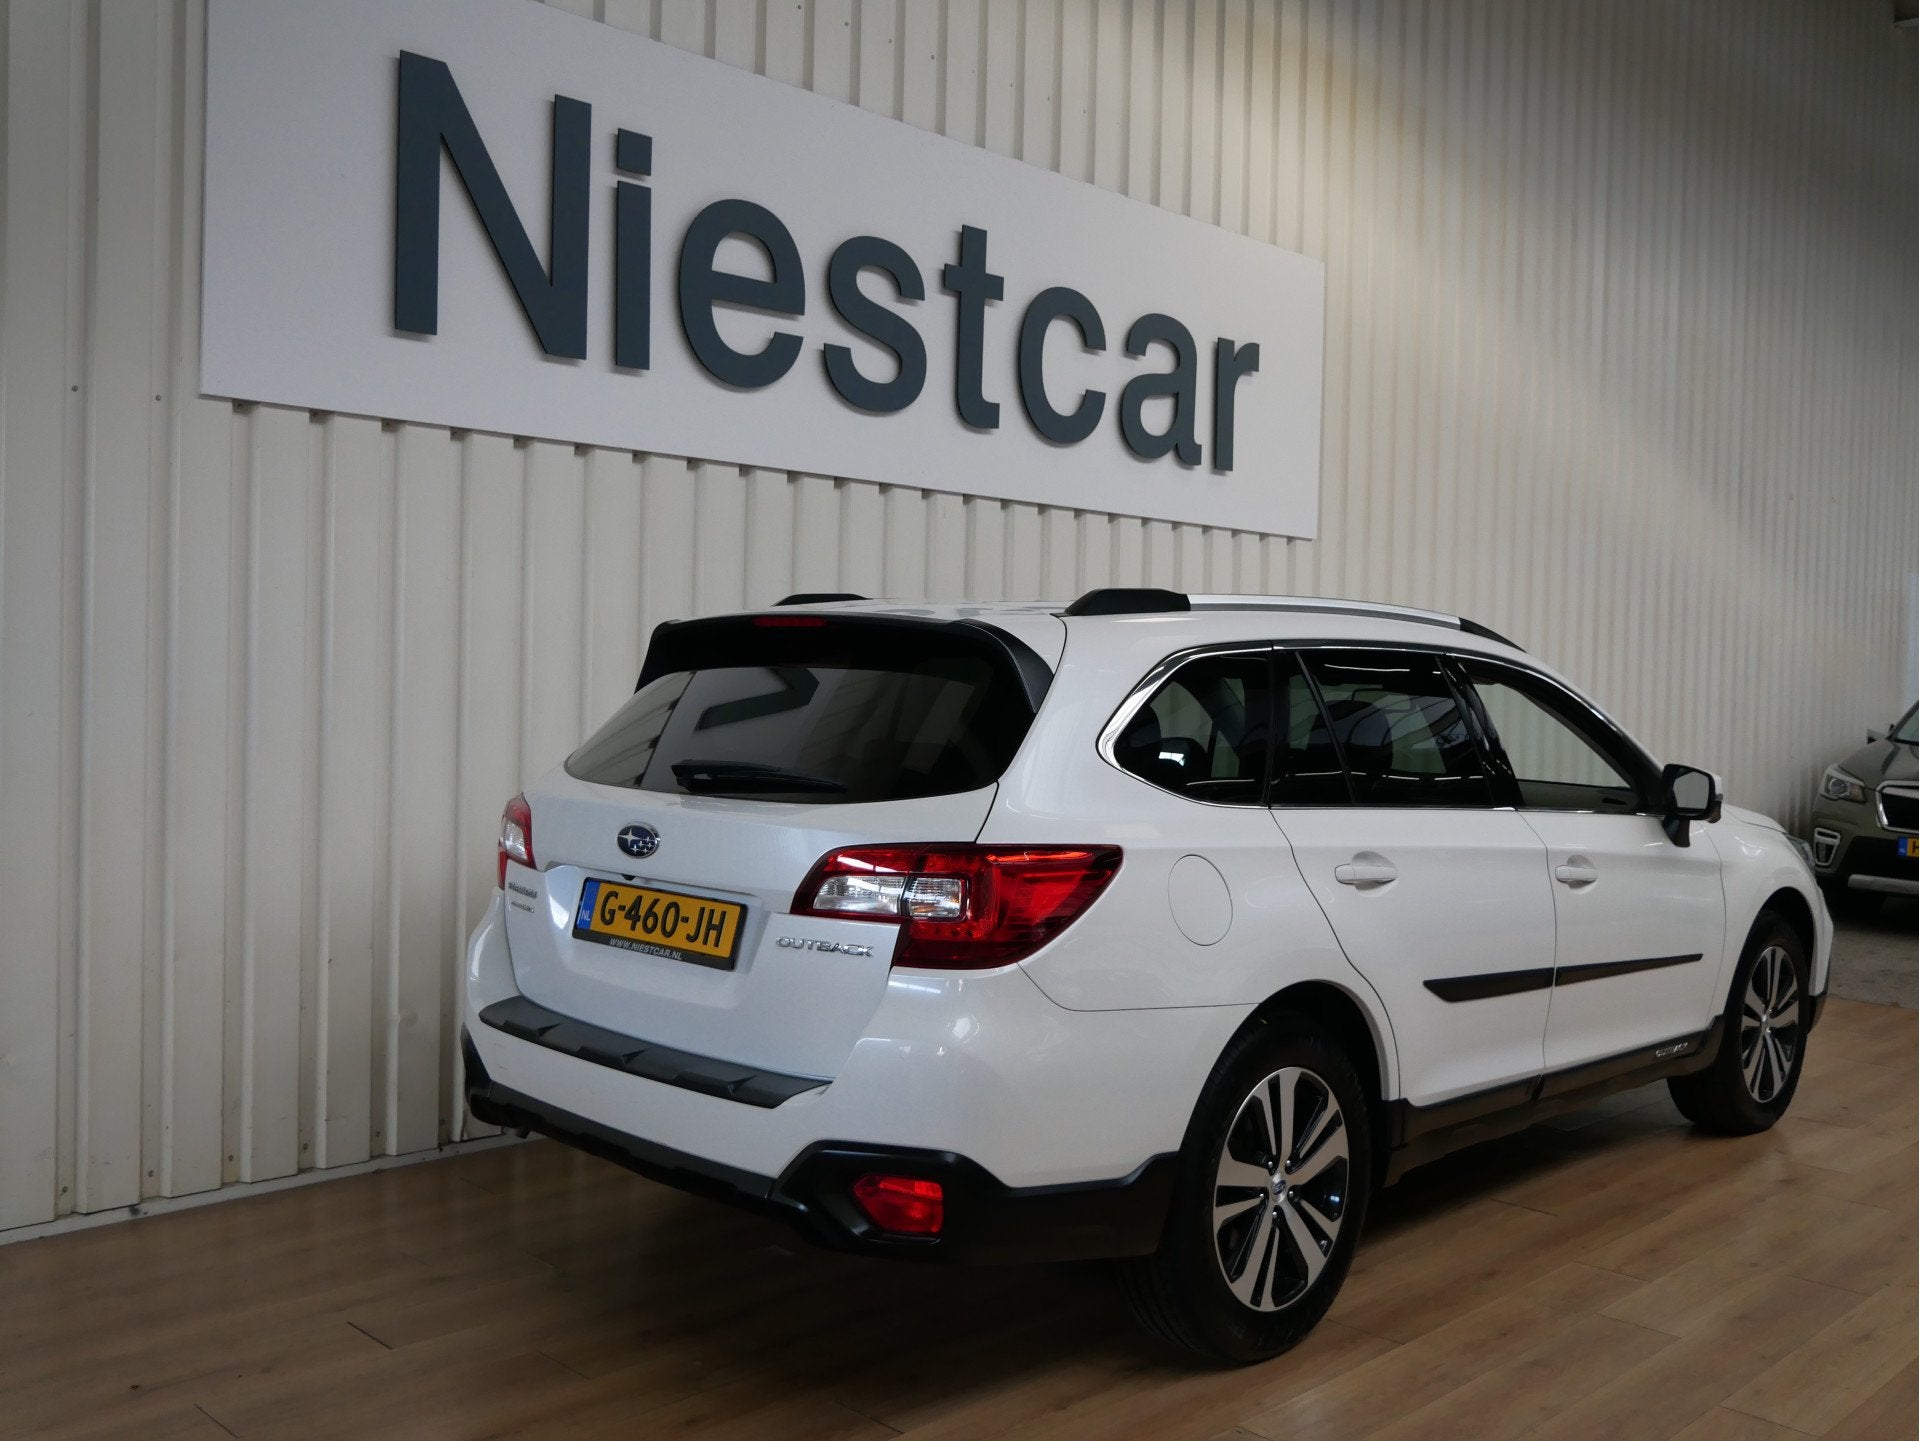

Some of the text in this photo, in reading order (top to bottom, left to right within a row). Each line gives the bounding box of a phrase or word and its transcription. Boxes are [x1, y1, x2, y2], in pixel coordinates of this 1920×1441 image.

[391, 50, 1260, 472] Niestcar
[580, 909, 591, 922] NL
[600, 890, 727, 948] G-460-JH
[609, 937, 682, 960] WWW.NIESTCAR.NL
[776, 936, 874, 958] OUTBACK
